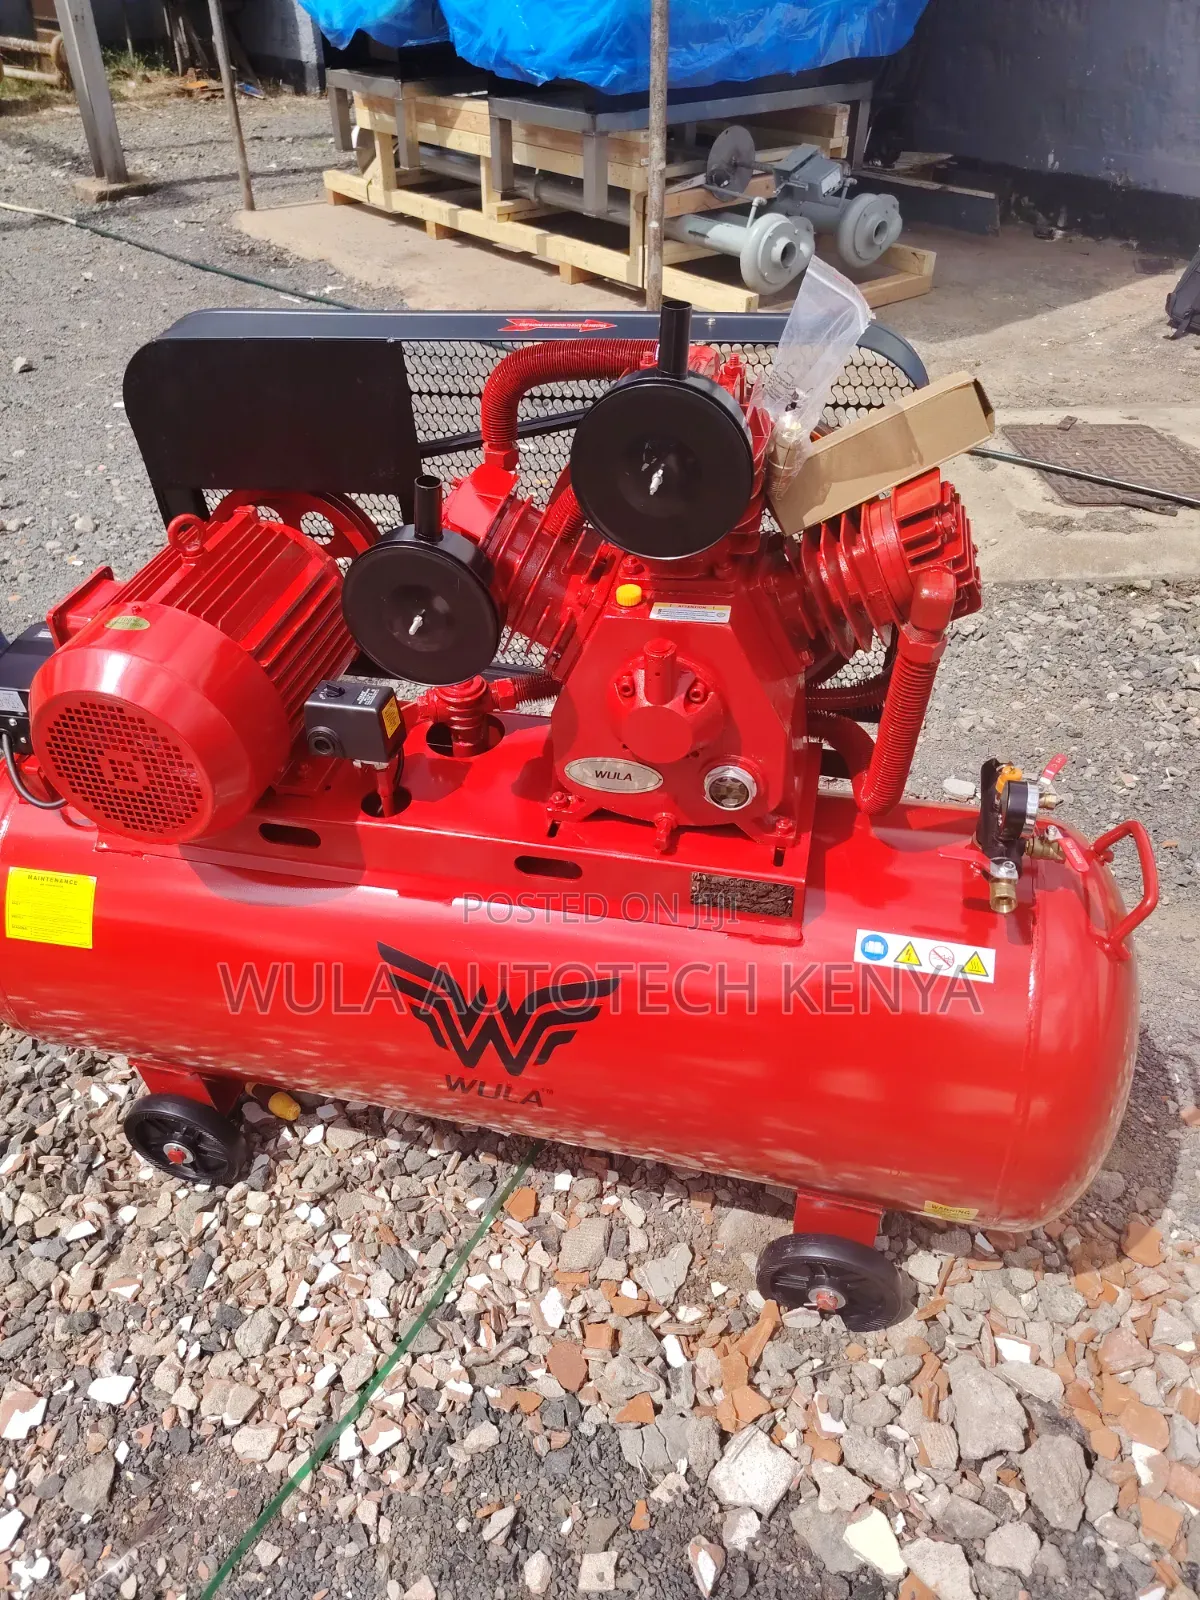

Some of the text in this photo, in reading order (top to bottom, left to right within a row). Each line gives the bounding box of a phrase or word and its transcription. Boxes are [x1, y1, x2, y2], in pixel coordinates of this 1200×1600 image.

[595, 770, 632, 782] WULA
[27, 874, 78, 886] MAINTENANCE
[445, 1074, 543, 1108] WULA
[931, 1204, 970, 1215] WARNING
